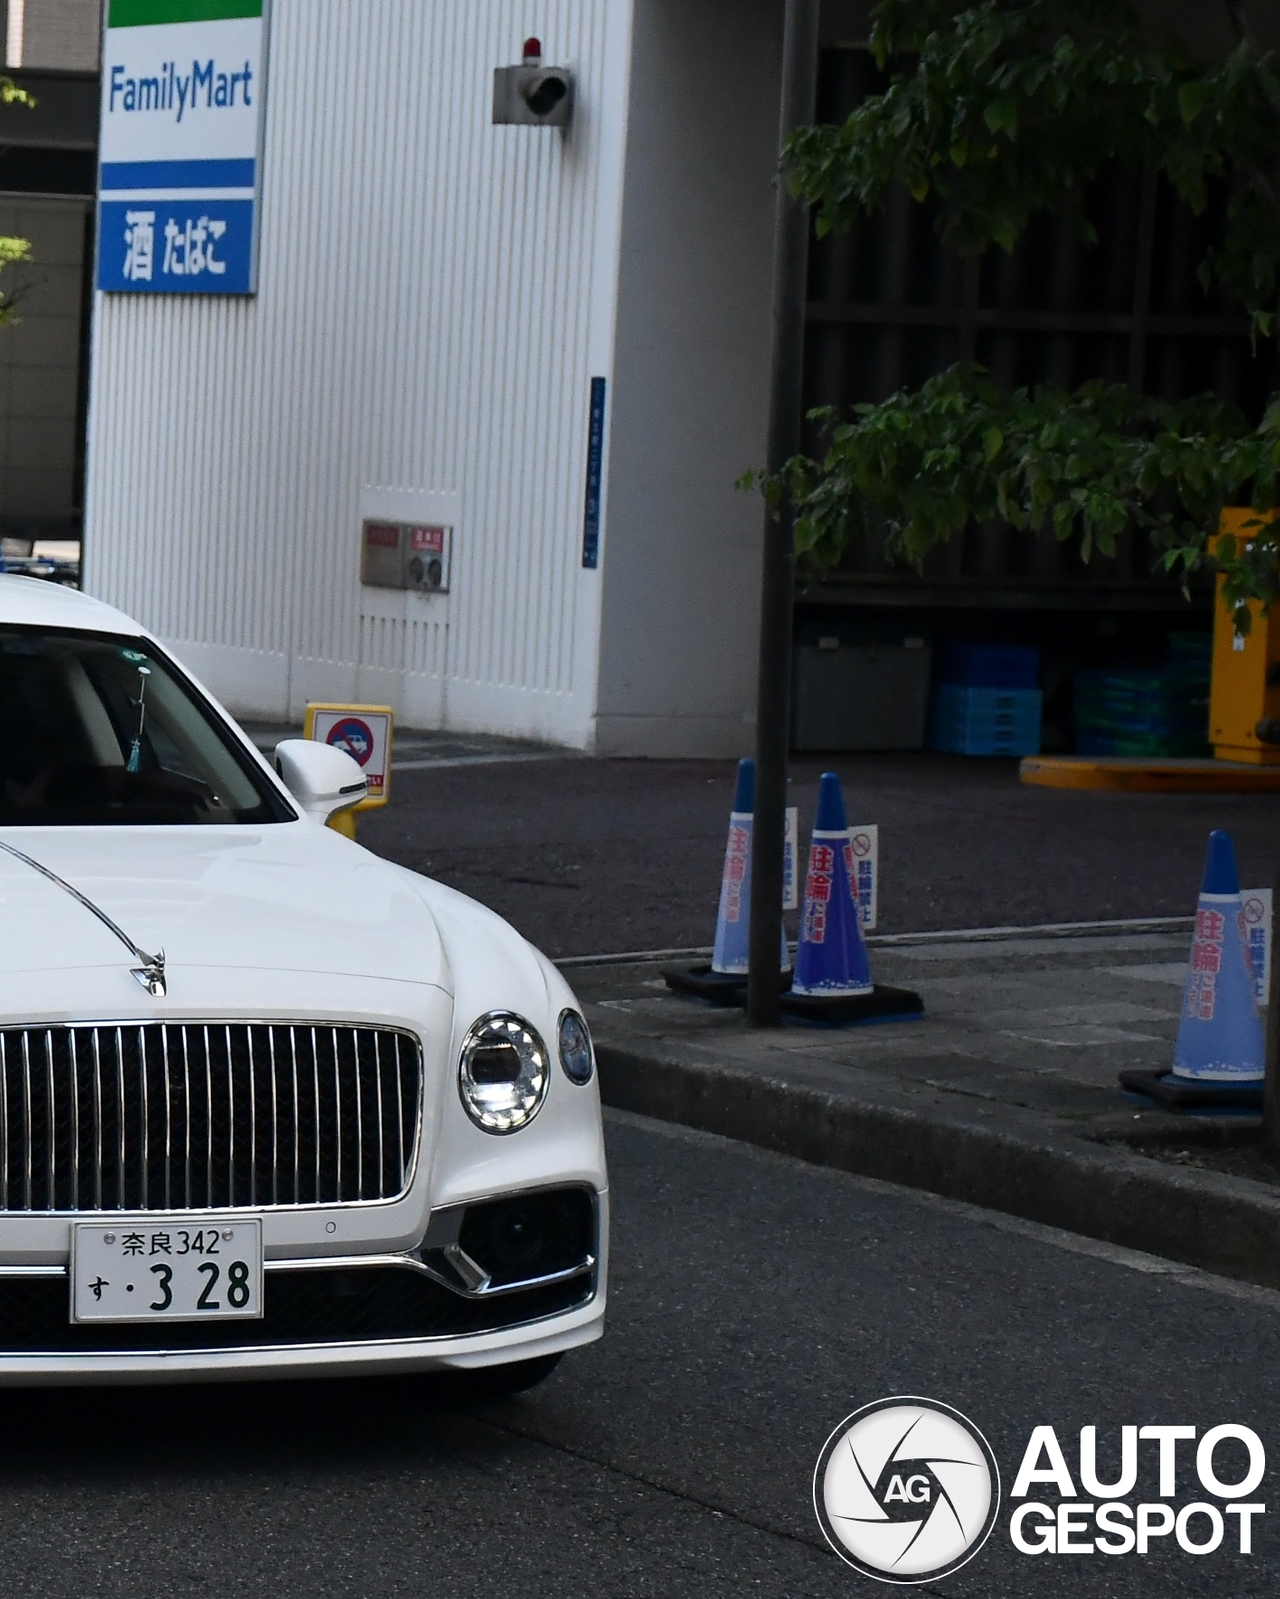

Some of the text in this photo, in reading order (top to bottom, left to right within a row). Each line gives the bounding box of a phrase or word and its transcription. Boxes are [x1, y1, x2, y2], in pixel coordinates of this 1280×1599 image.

[109, 59, 252, 123] FamilyMart
[123, 210, 227, 281] 酒 たばこ
[121, 1229, 221, 1256] 奈良342
